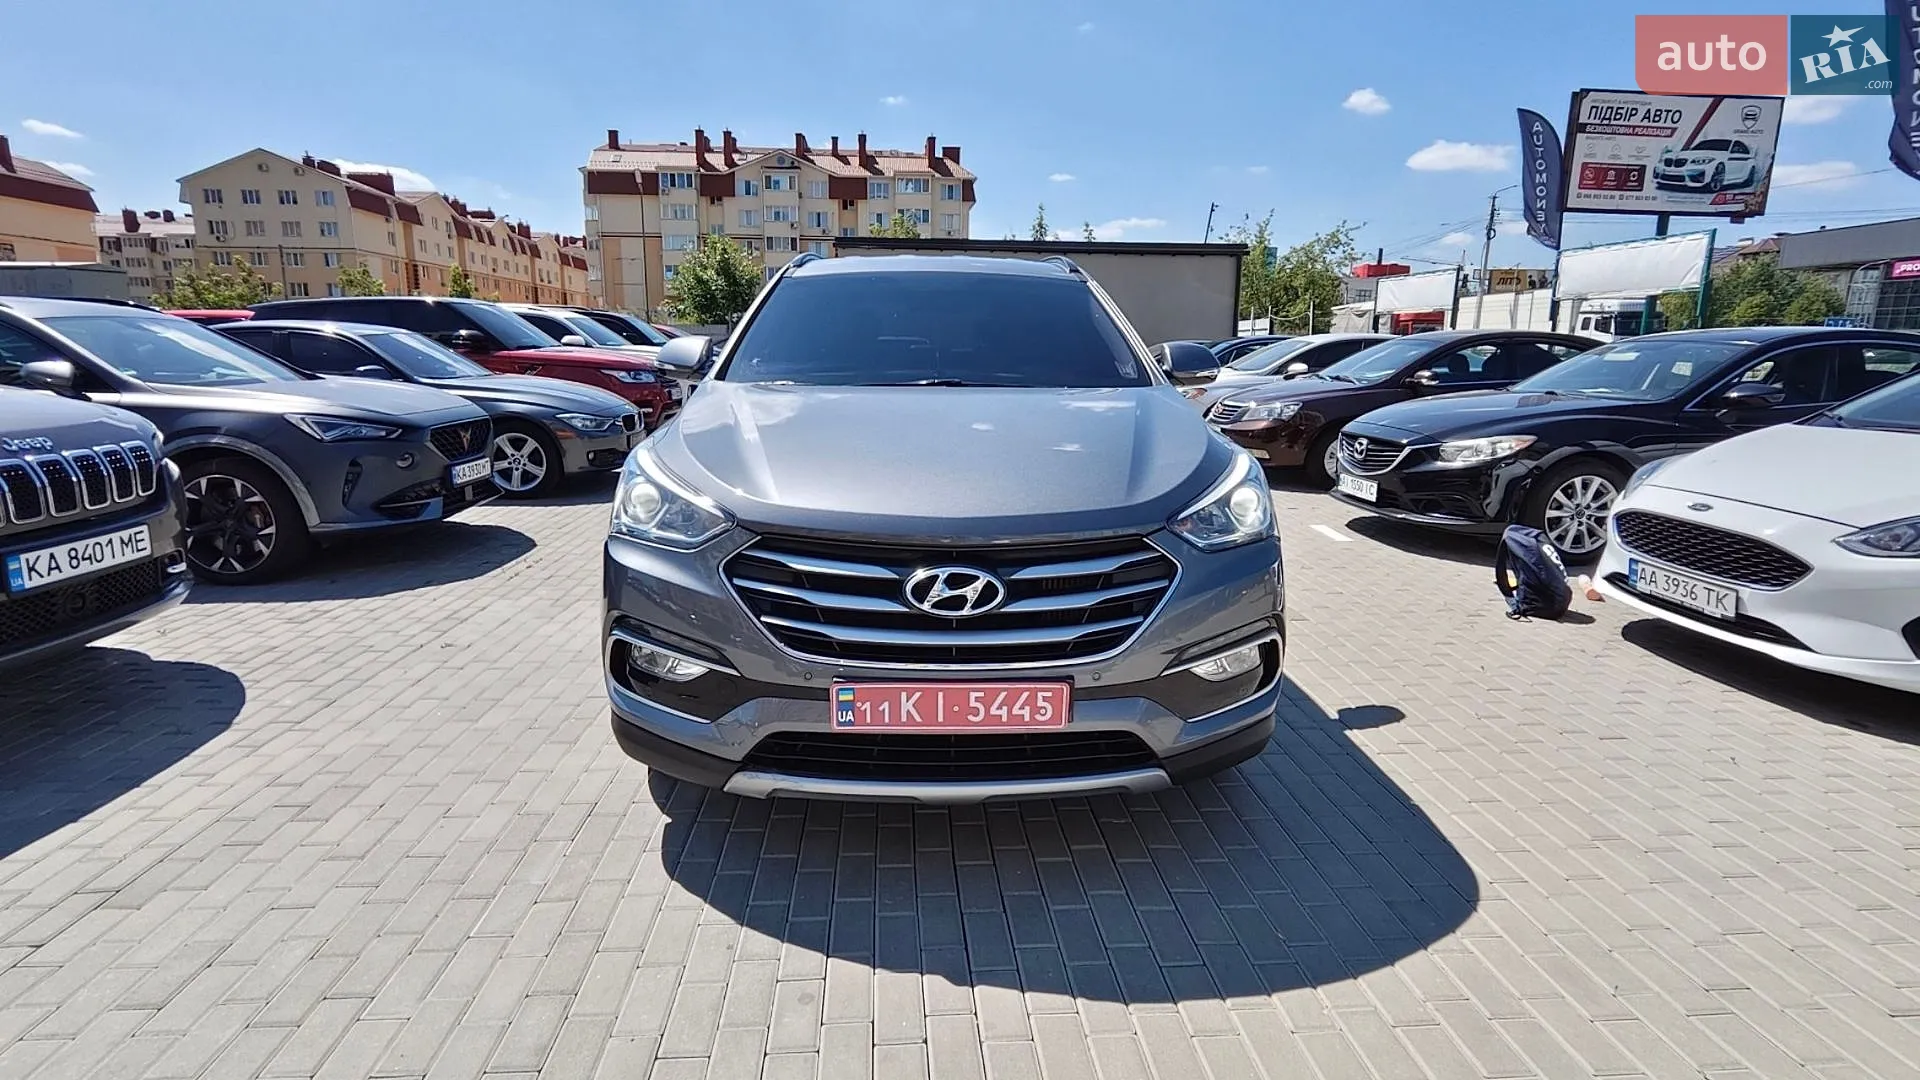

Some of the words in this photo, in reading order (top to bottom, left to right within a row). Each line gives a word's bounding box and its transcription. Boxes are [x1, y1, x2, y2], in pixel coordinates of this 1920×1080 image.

[1587, 105, 1639, 124] ПІДБІР
[1640, 108, 1683, 125] АВТО
[2, 436, 54, 452] Jeep
[25, 552, 63, 582] KA
[67, 537, 116, 570] 8401
[120, 530, 148, 557] ME
[10, 577, 23, 587] UA
[1638, 567, 1658, 589] AA
[1662, 574, 1698, 601] 3936
[1702, 586, 1730, 612] TK
[838, 711, 854, 722] UA
[967, 691, 1054, 722] 5445
